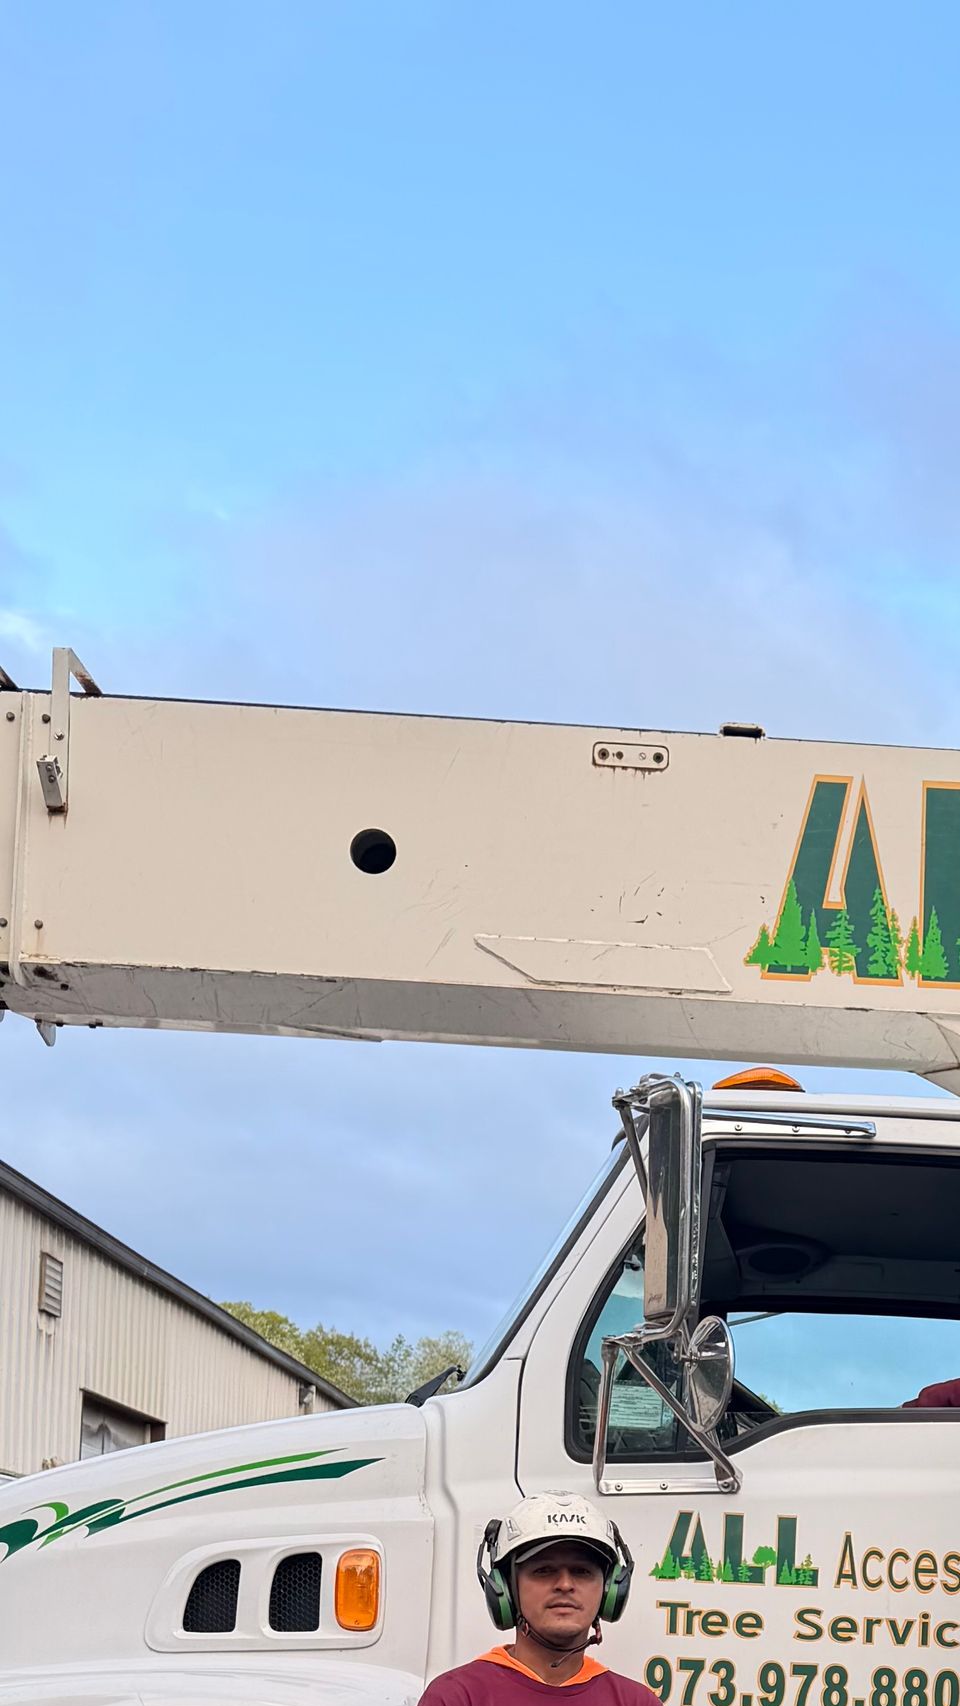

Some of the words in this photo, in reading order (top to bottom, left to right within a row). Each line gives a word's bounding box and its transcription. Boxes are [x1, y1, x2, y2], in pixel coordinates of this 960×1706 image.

[547, 1513, 587, 1525] KASK
[652, 1509, 820, 1589] ALL
[656, 1600, 765, 1639] Tree
